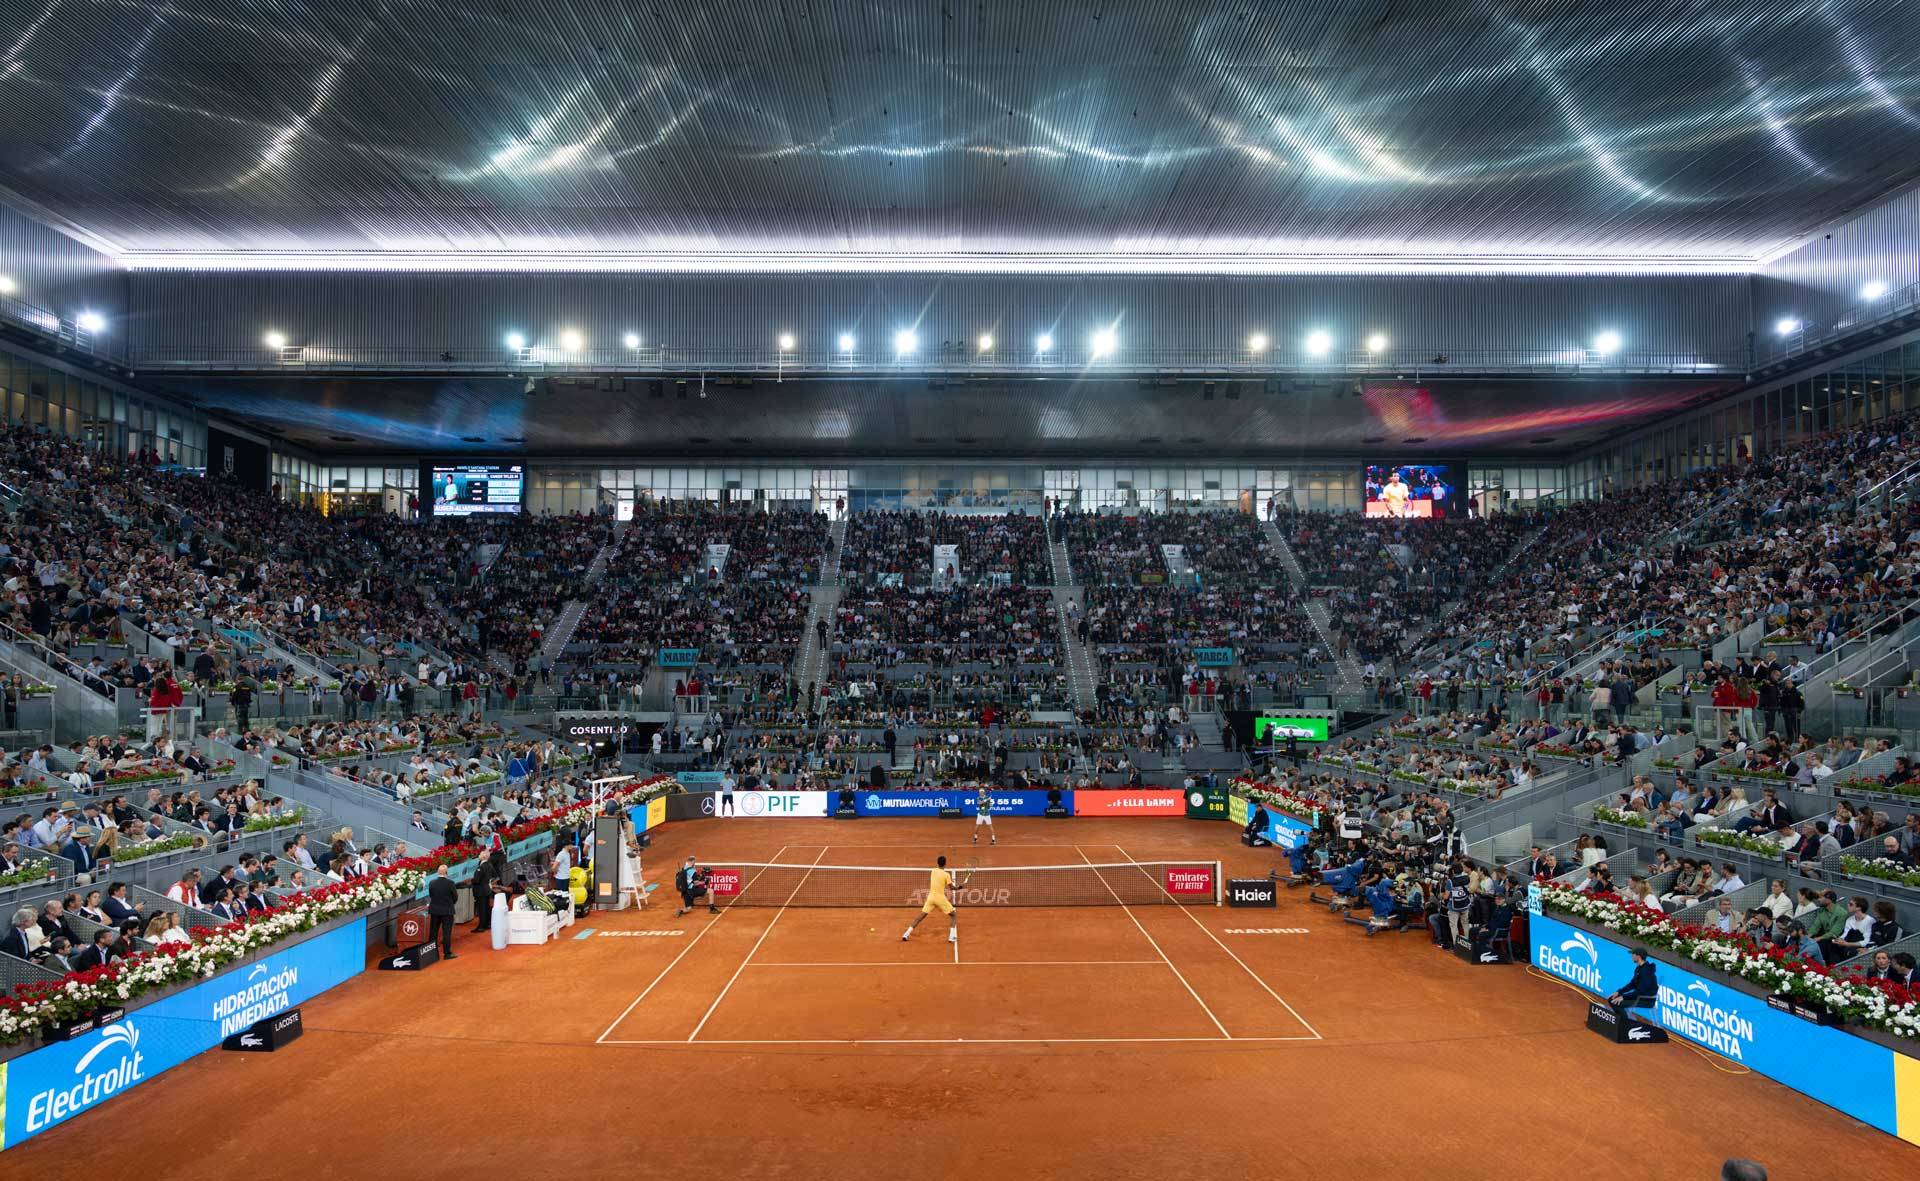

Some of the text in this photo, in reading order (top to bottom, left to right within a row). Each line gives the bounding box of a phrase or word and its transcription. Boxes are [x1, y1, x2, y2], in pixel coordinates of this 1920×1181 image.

[570, 725, 628, 735] COSENTIO
[768, 795, 800, 812] PIF
[1209, 802, 1224, 811] 0:00
[1169, 872, 1209, 882] Emirates
[1175, 882, 1203, 890] FLY BETTER
[956, 888, 1011, 905] TOUR
[1234, 888, 1272, 902] Haier
[1456, 937, 1472, 950] LACOSTE
[1539, 944, 1601, 993] Electrolit
[213, 966, 298, 1022] HIDRATACIÓN
[221, 991, 290, 1039] INMEDIATA
[275, 1012, 299, 1033] LACOSTE
[1591, 1005, 1616, 1024] LACOSTE
[1662, 1006, 1743, 1060] INMEDIATA
[26, 1050, 145, 1133] Electrolit
